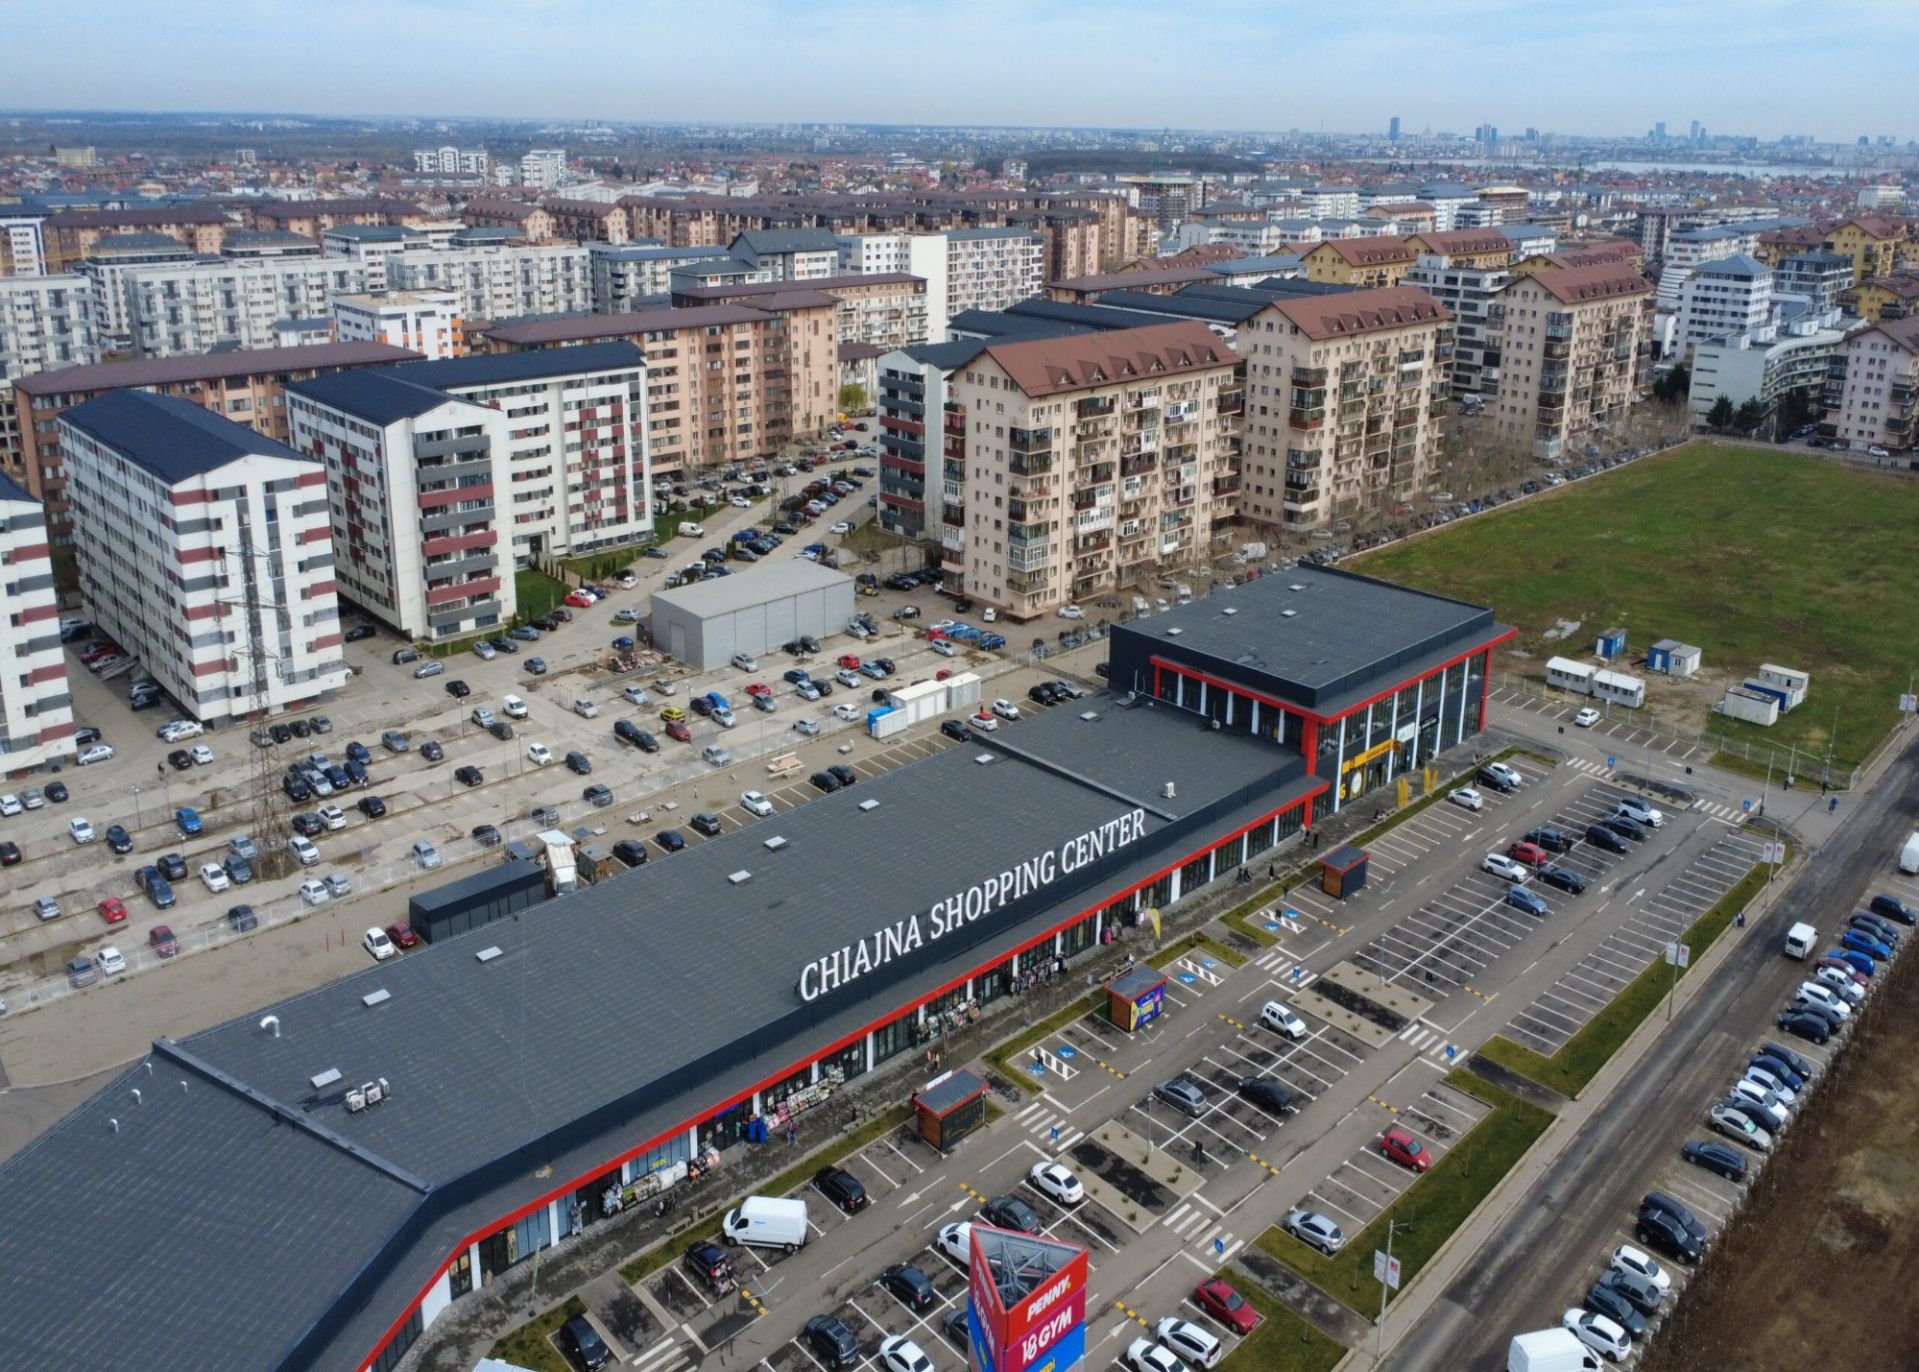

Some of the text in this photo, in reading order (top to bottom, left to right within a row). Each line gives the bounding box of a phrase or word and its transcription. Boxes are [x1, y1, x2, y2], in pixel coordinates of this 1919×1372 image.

[800, 808, 1145, 1001] CHIAJNA SHOPPING CENTER
